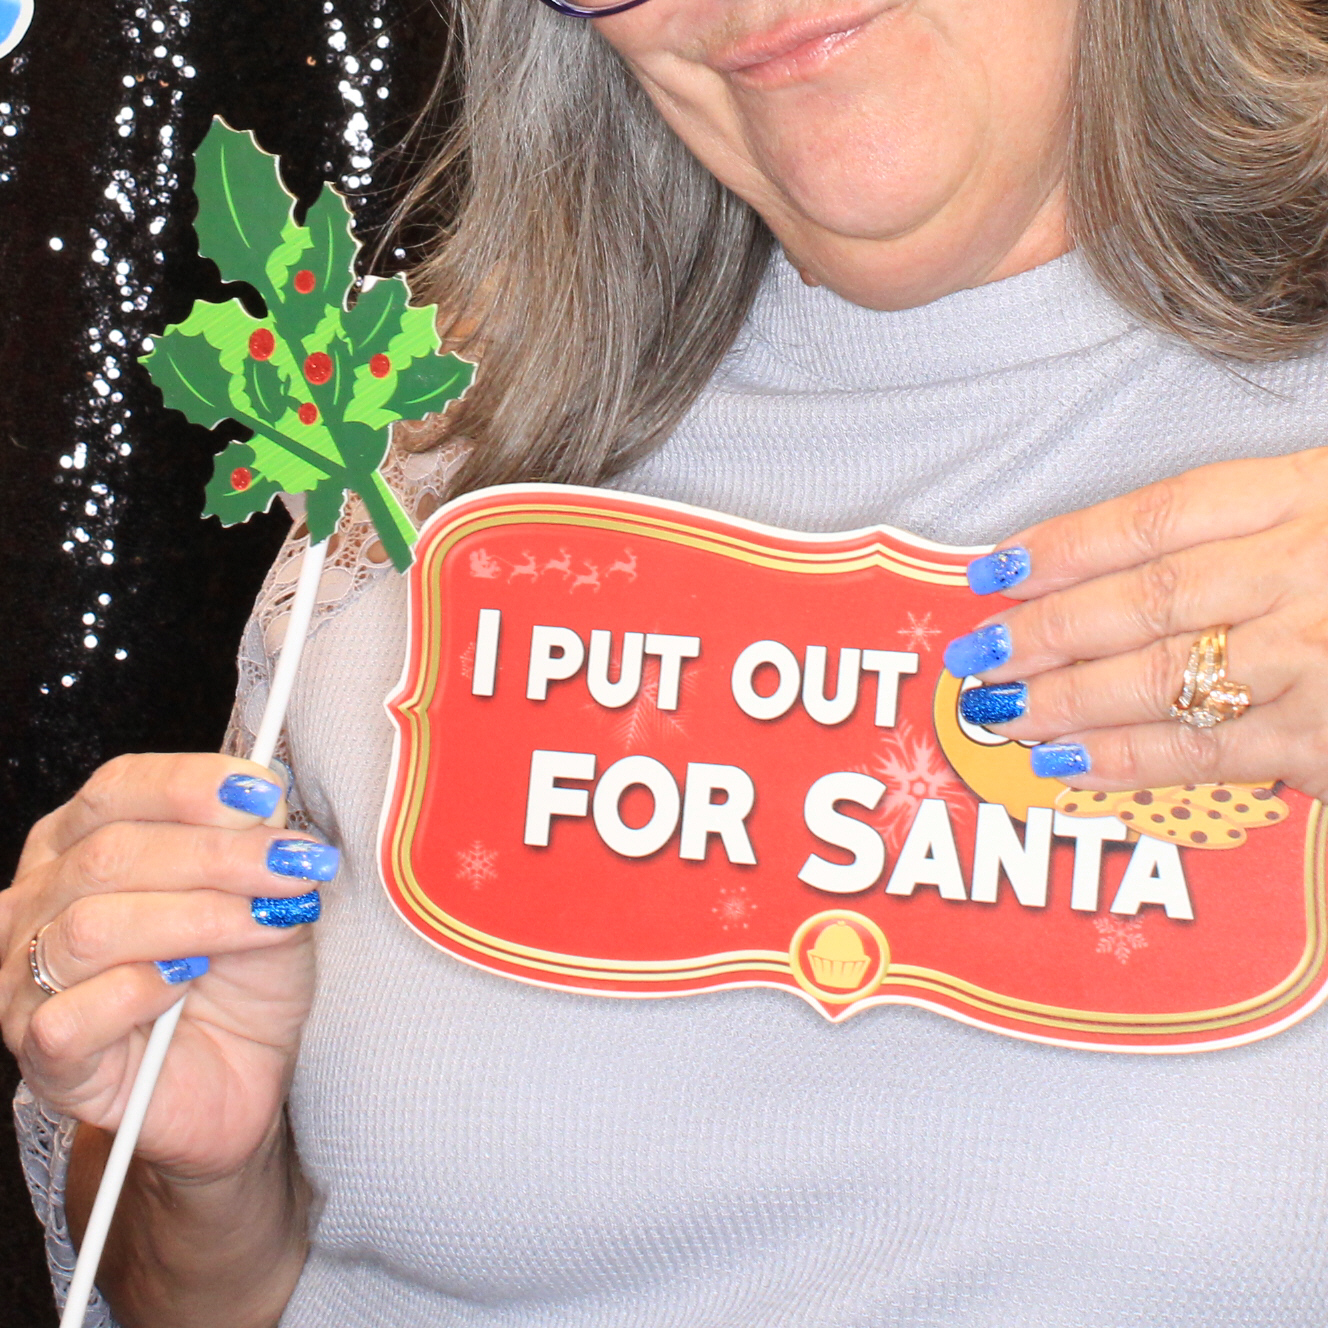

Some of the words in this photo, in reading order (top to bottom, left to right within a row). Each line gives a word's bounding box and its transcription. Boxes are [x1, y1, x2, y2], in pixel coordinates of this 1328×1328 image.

[471, 608, 502, 697] I
[526, 624, 700, 712] PUT
[731, 639, 919, 728] OUT
[523, 748, 757, 866] FOR
[797, 770, 1194, 922] SANTA
